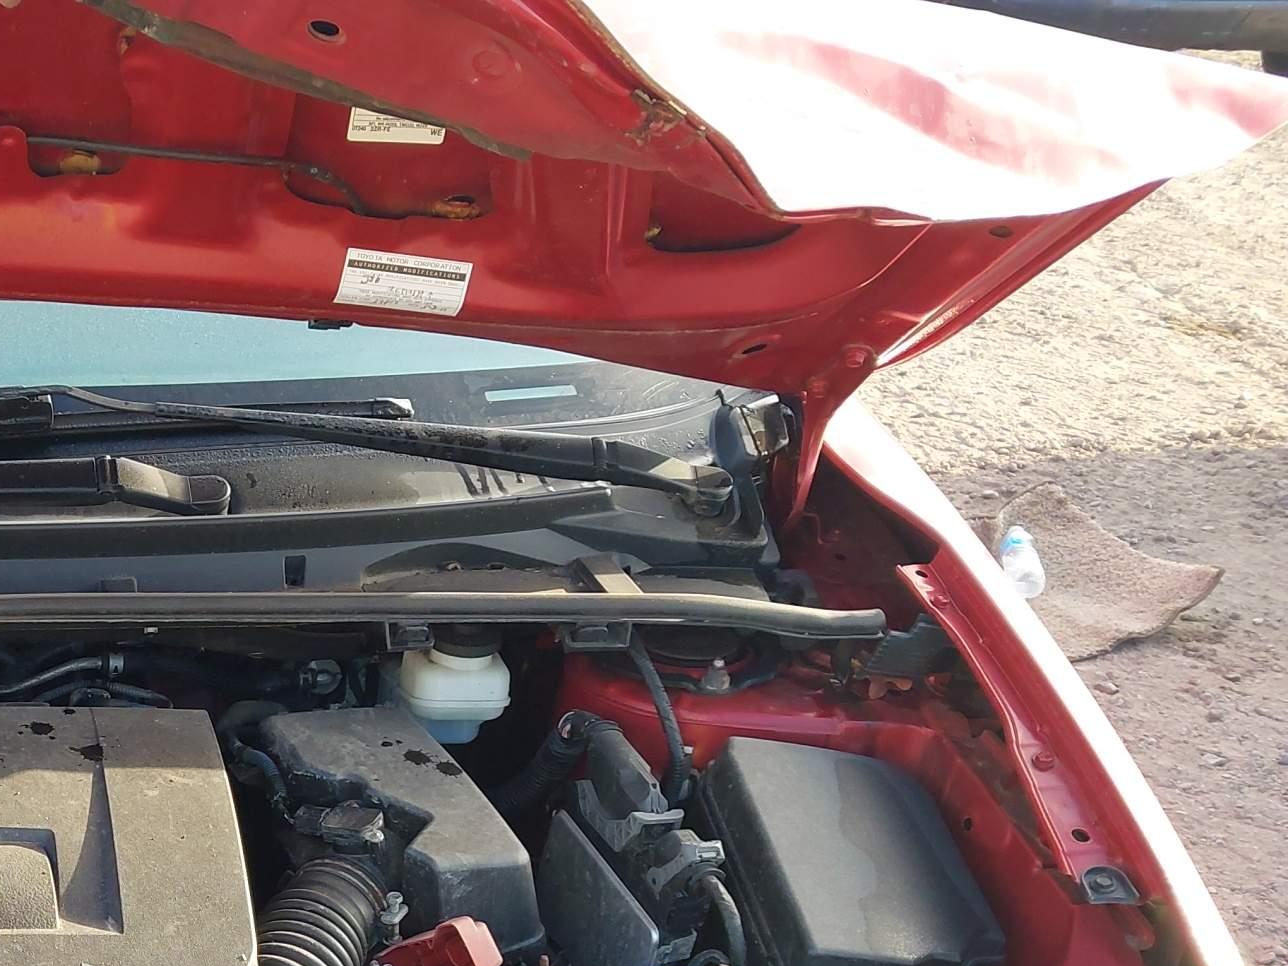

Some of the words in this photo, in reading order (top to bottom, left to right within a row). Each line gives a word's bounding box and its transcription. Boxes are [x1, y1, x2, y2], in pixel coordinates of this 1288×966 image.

[352, 260, 399, 271] AUTHORIZED
[402, 267, 461, 279] MODIFICATIONS
[356, 251, 383, 261] TOYOTA
[385, 255, 409, 264] MOTOR
[412, 259, 462, 271] CORPORATION
